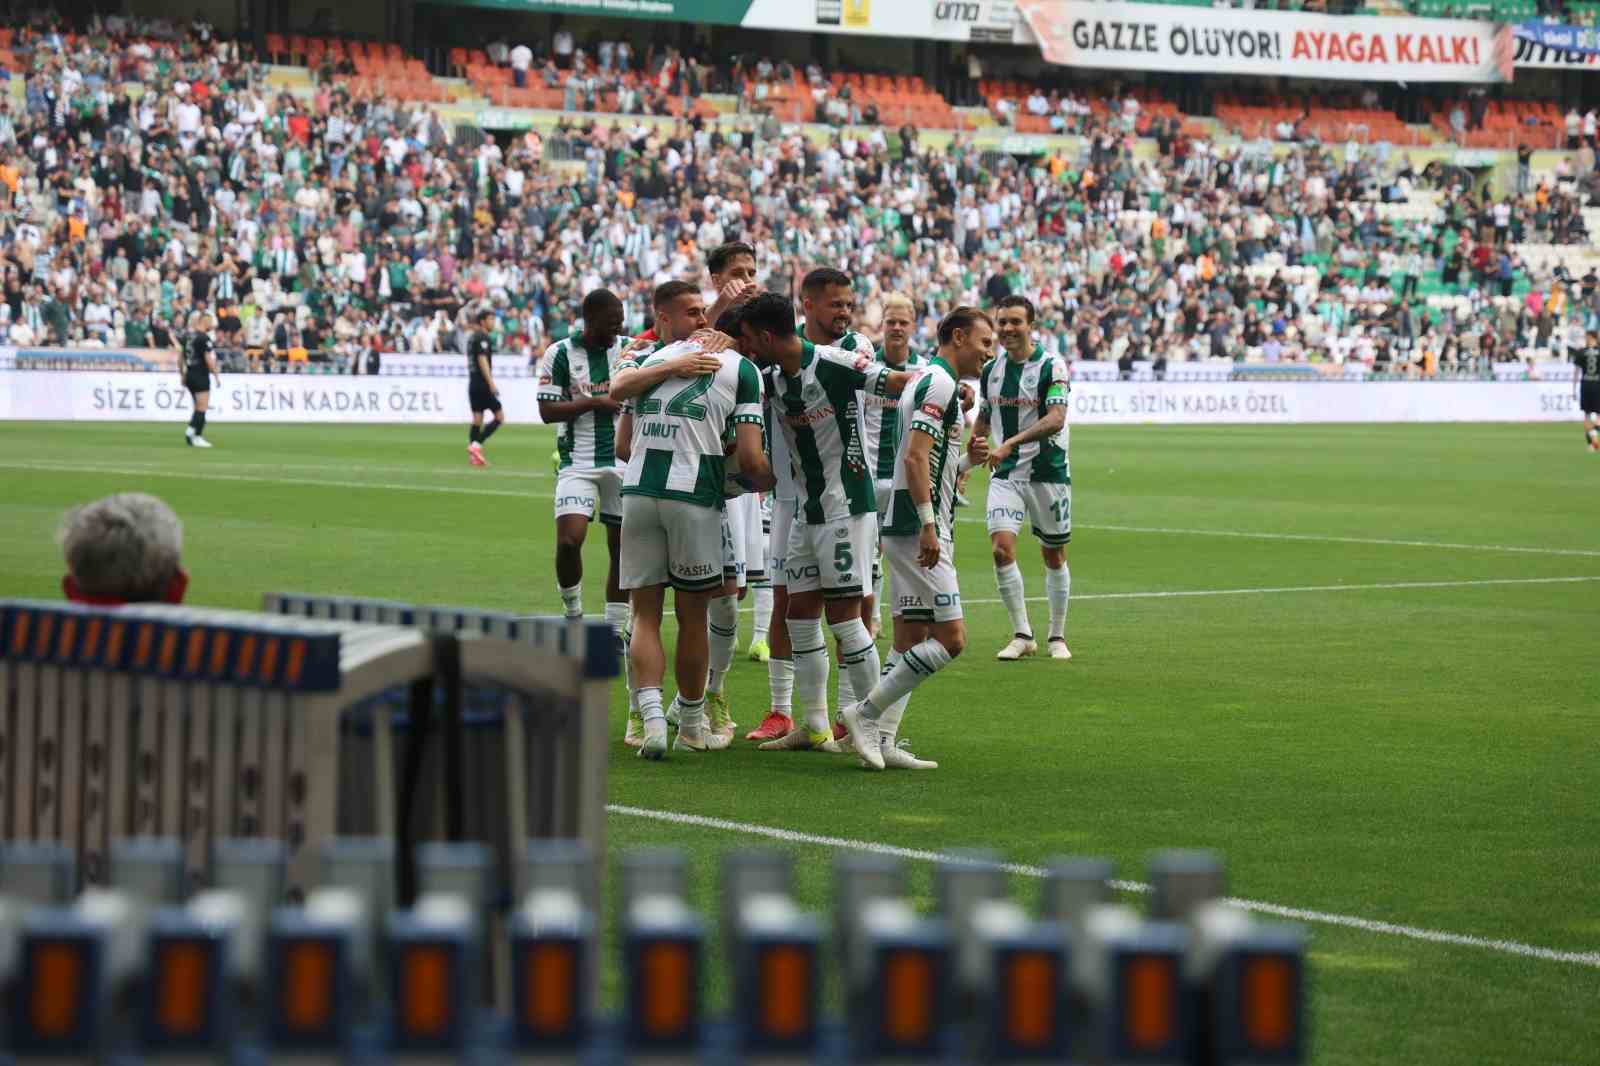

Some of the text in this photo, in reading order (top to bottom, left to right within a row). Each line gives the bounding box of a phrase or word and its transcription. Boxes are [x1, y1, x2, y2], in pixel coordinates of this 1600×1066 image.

[1073, 20, 1158, 52] GAZZE
[1169, 22, 1281, 60] ÖLÜYOR!
[1396, 33, 1480, 65] KALK!
[93, 381, 146, 409] SİZE
[232, 383, 294, 411] SİZİN
[304, 390, 381, 411] KADAR
[388, 385, 444, 411] ÖZEL
[1183, 394, 1240, 413] KADAR
[642, 422, 680, 439] UMUT
[1050, 497, 1069, 522] 12
[833, 542, 853, 572] 5
